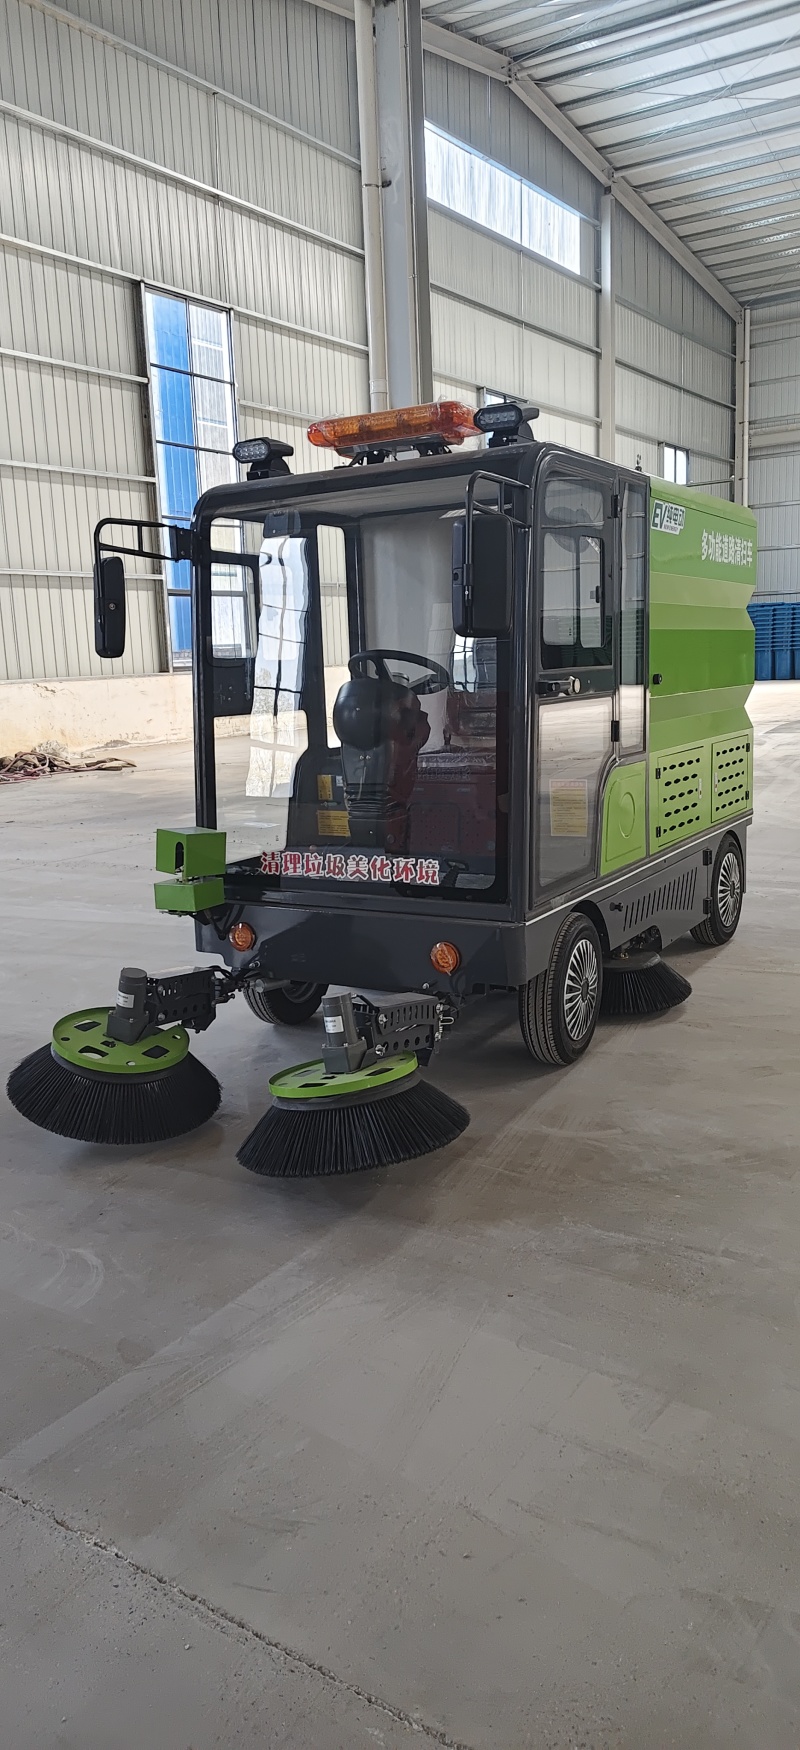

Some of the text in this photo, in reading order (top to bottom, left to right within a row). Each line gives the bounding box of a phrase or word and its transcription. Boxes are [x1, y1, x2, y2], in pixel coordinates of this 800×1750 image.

[652, 502, 668, 529] EV
[701, 529, 753, 566] 多功能道路清扫车
[261, 851, 440, 885] 清理垃圾美化环境
